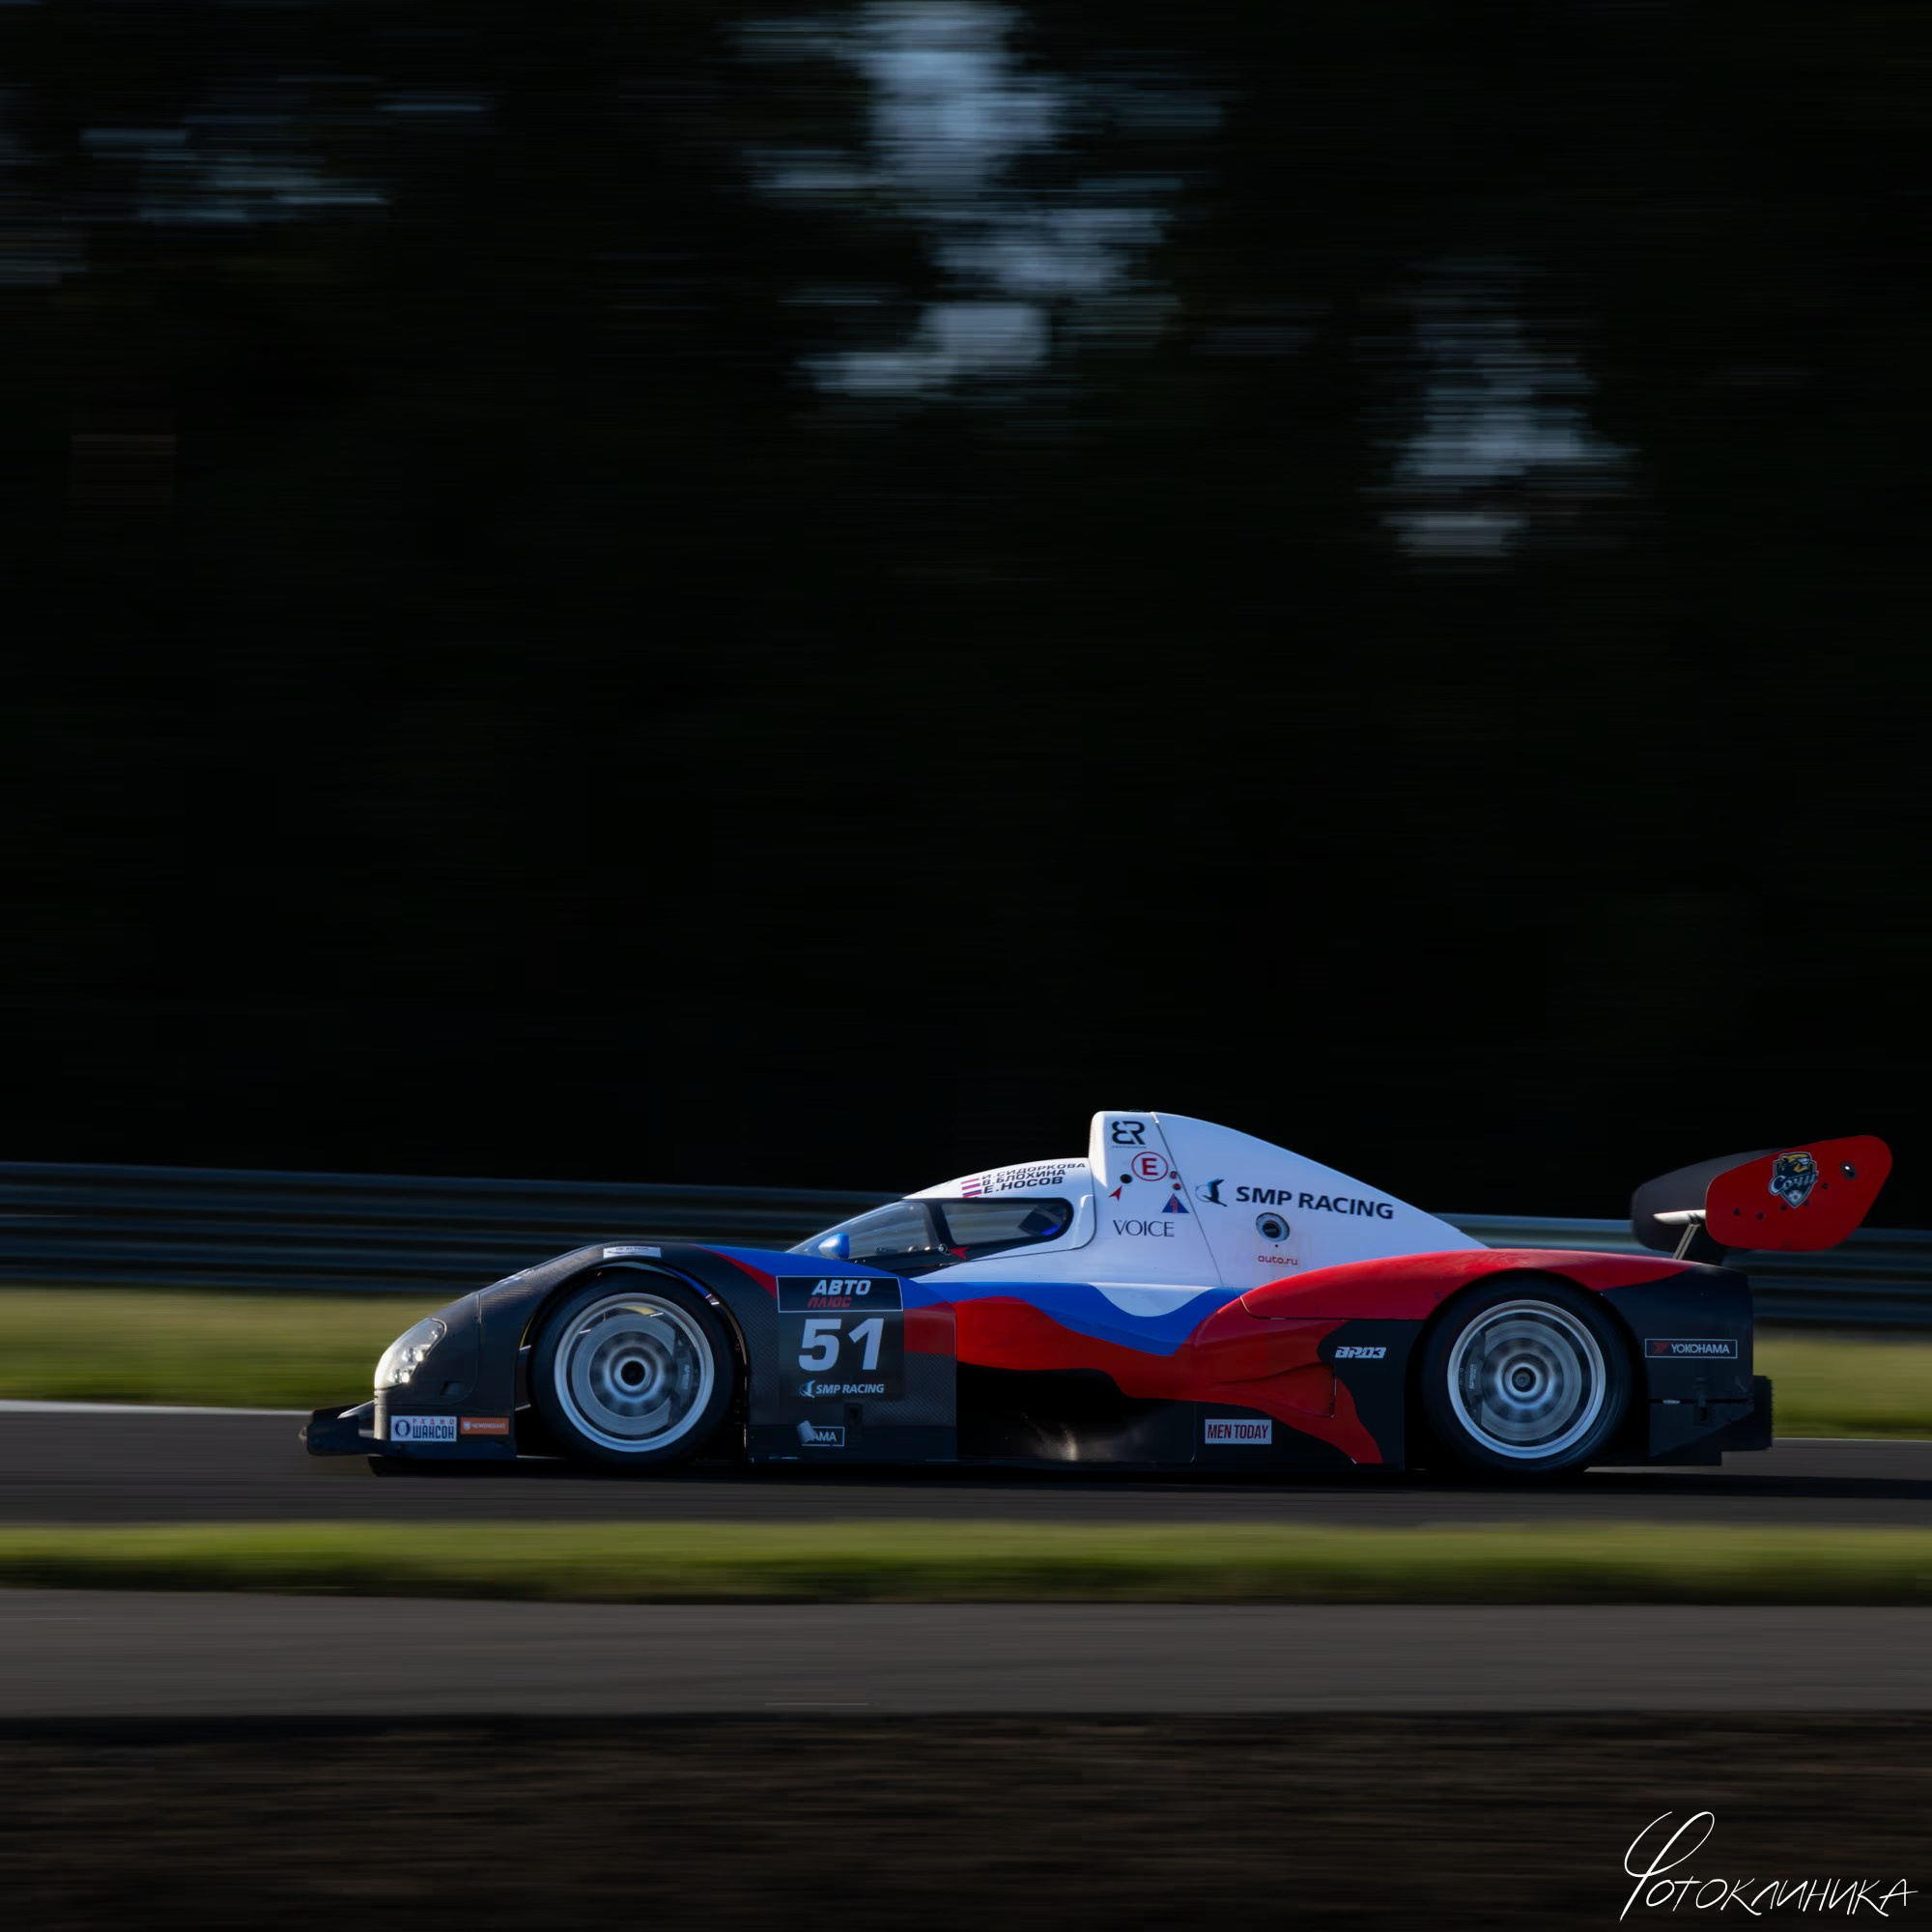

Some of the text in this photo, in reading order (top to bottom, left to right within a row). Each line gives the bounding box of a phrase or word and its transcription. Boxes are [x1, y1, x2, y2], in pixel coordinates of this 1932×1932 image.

[1141, 1157, 1158, 1176] E
[1236, 1185, 1394, 1220] SMP RACING
[1112, 1219, 1176, 1237] VOICE
[1258, 1255, 1298, 1266] auto.ru
[811, 1279, 871, 1295] АВТО
[798, 1318, 885, 1372] 51
[1670, 1343, 1730, 1354] YOKOHAMA
[815, 1383, 885, 1394] SMP RACING
[412, 1425, 455, 1439] ШАНСОН
[1208, 1424, 1269, 1439] MEN TODAY
